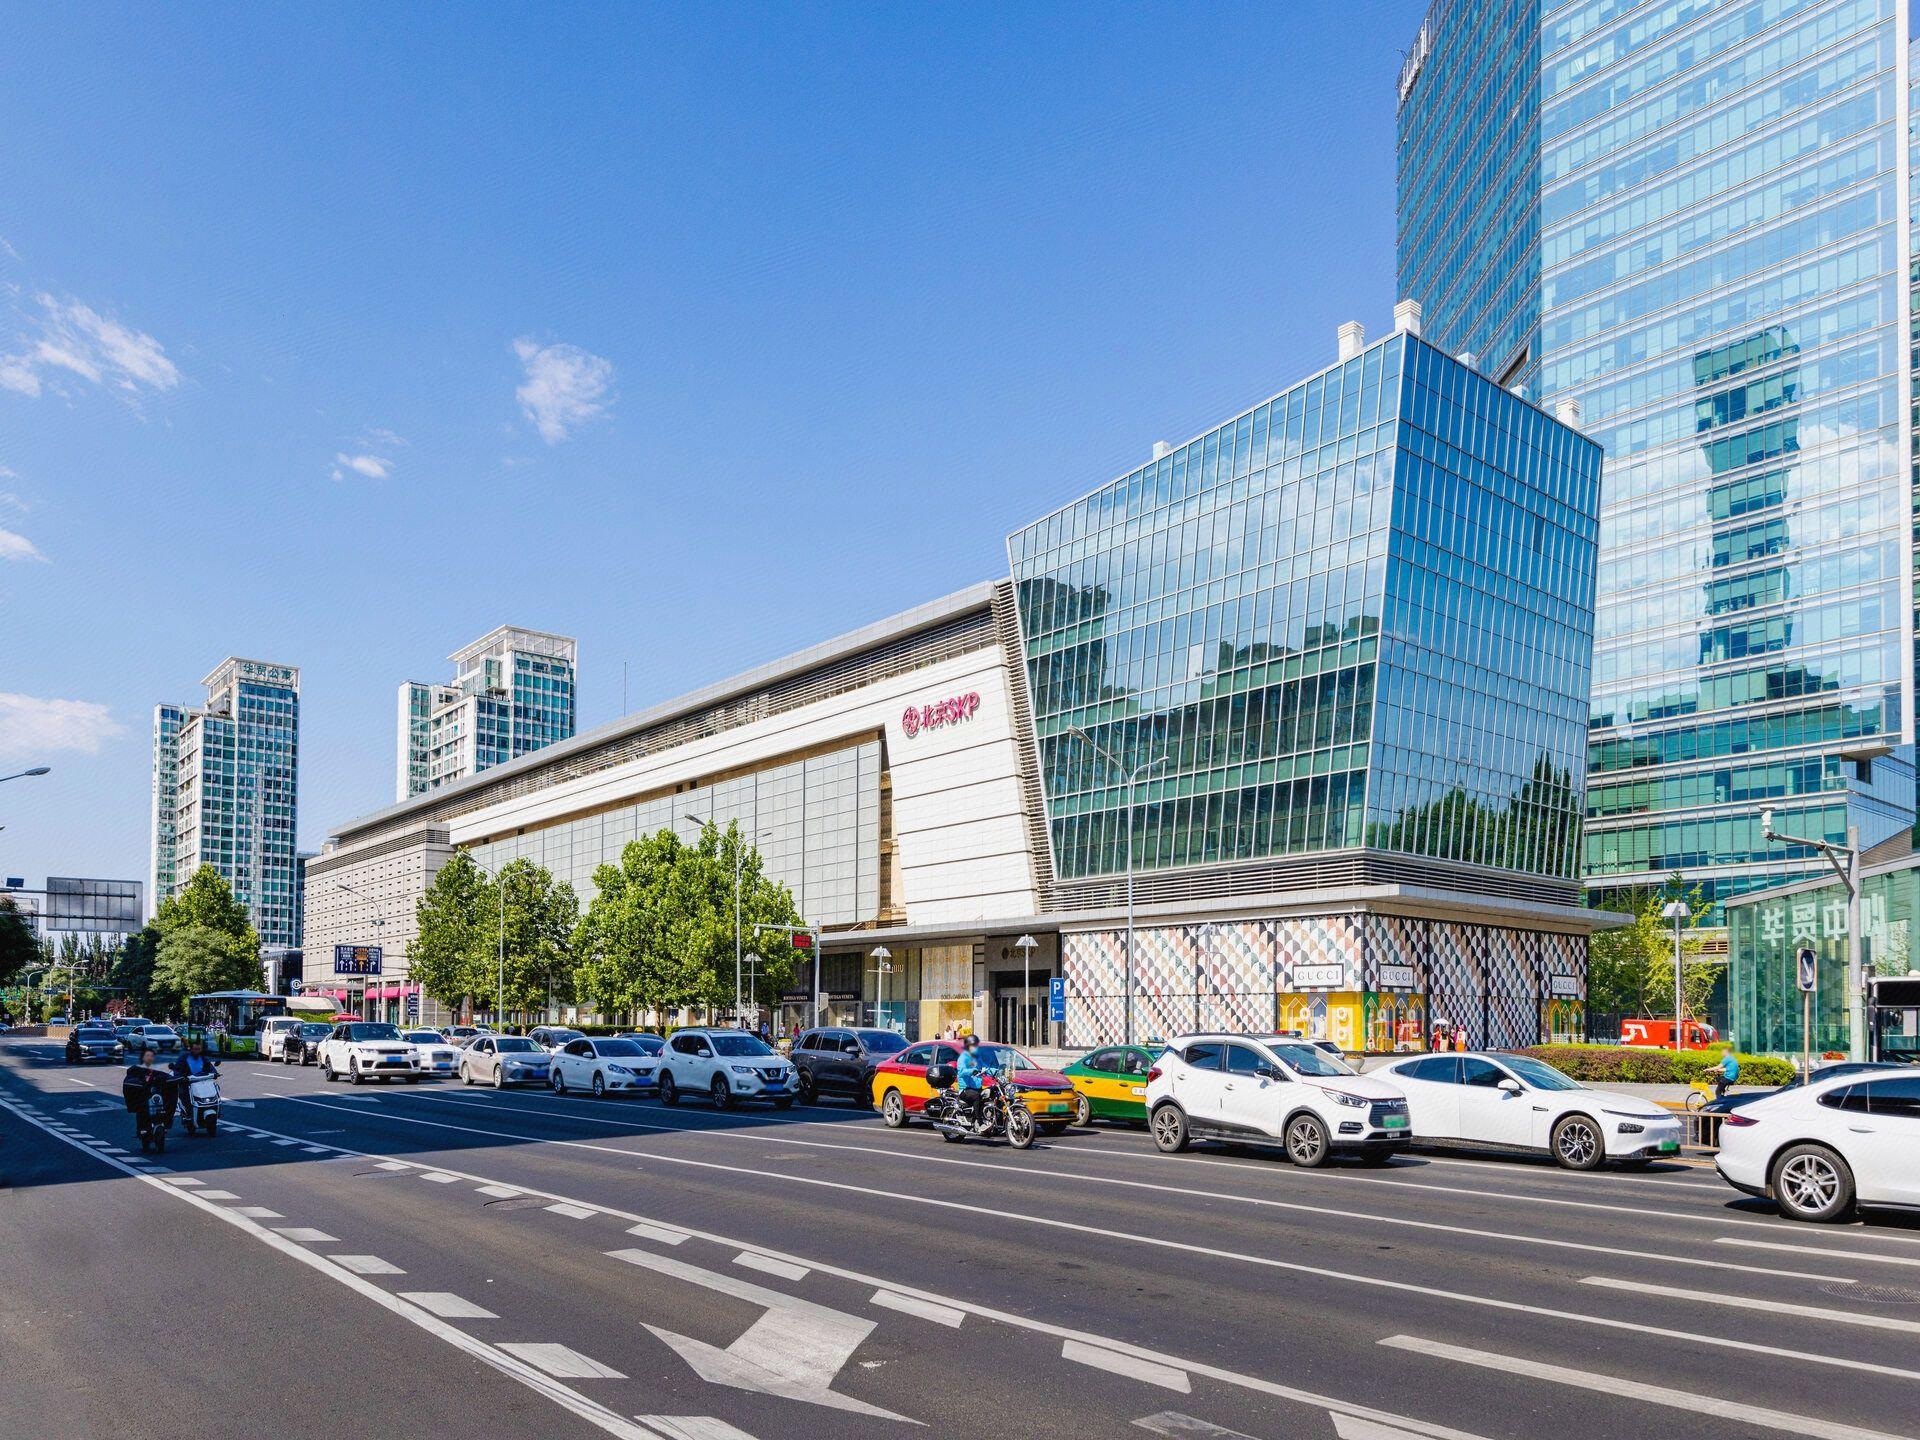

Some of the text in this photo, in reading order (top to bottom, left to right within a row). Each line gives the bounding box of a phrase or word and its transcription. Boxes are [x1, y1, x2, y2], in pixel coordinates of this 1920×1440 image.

[921, 692, 981, 728] 北京SKP
[1298, 969, 1339, 981] GUCCI
[1382, 970, 1411, 981] GUCCI
[1053, 981, 1061, 995] P
[1553, 980, 1575, 990] GUCCI
